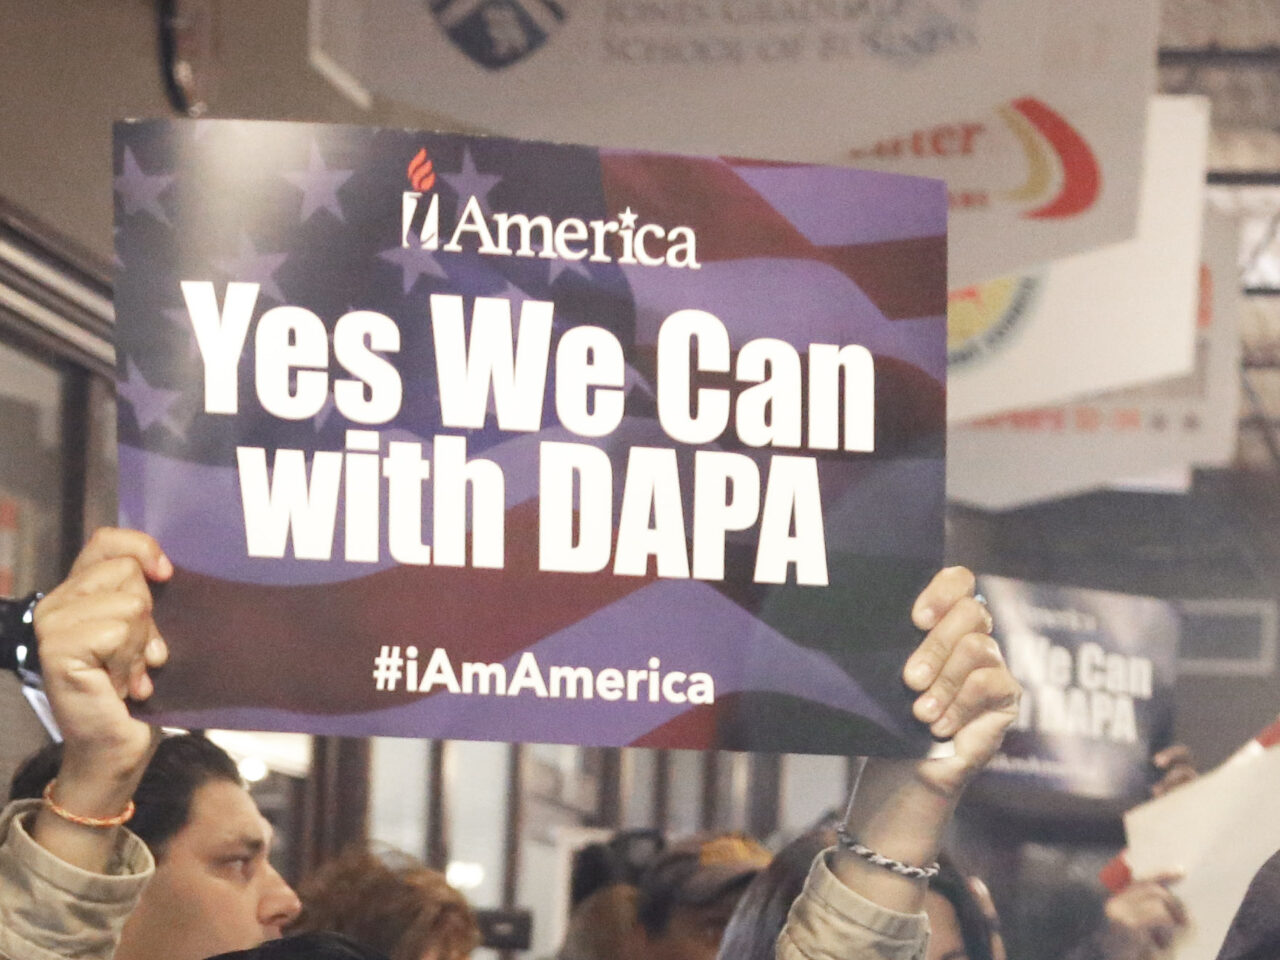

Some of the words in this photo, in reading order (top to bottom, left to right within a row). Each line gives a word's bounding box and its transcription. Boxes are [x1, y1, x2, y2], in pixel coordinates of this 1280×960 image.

[180, 280, 402, 424] Yes
[429, 293, 625, 438] We
[657, 308, 876, 453] Can
[236, 429, 506, 569] with
[538, 440, 830, 587] DAPA
[372, 645, 716, 706] #iAmAmerica
[1078, 641, 1154, 700] Can
